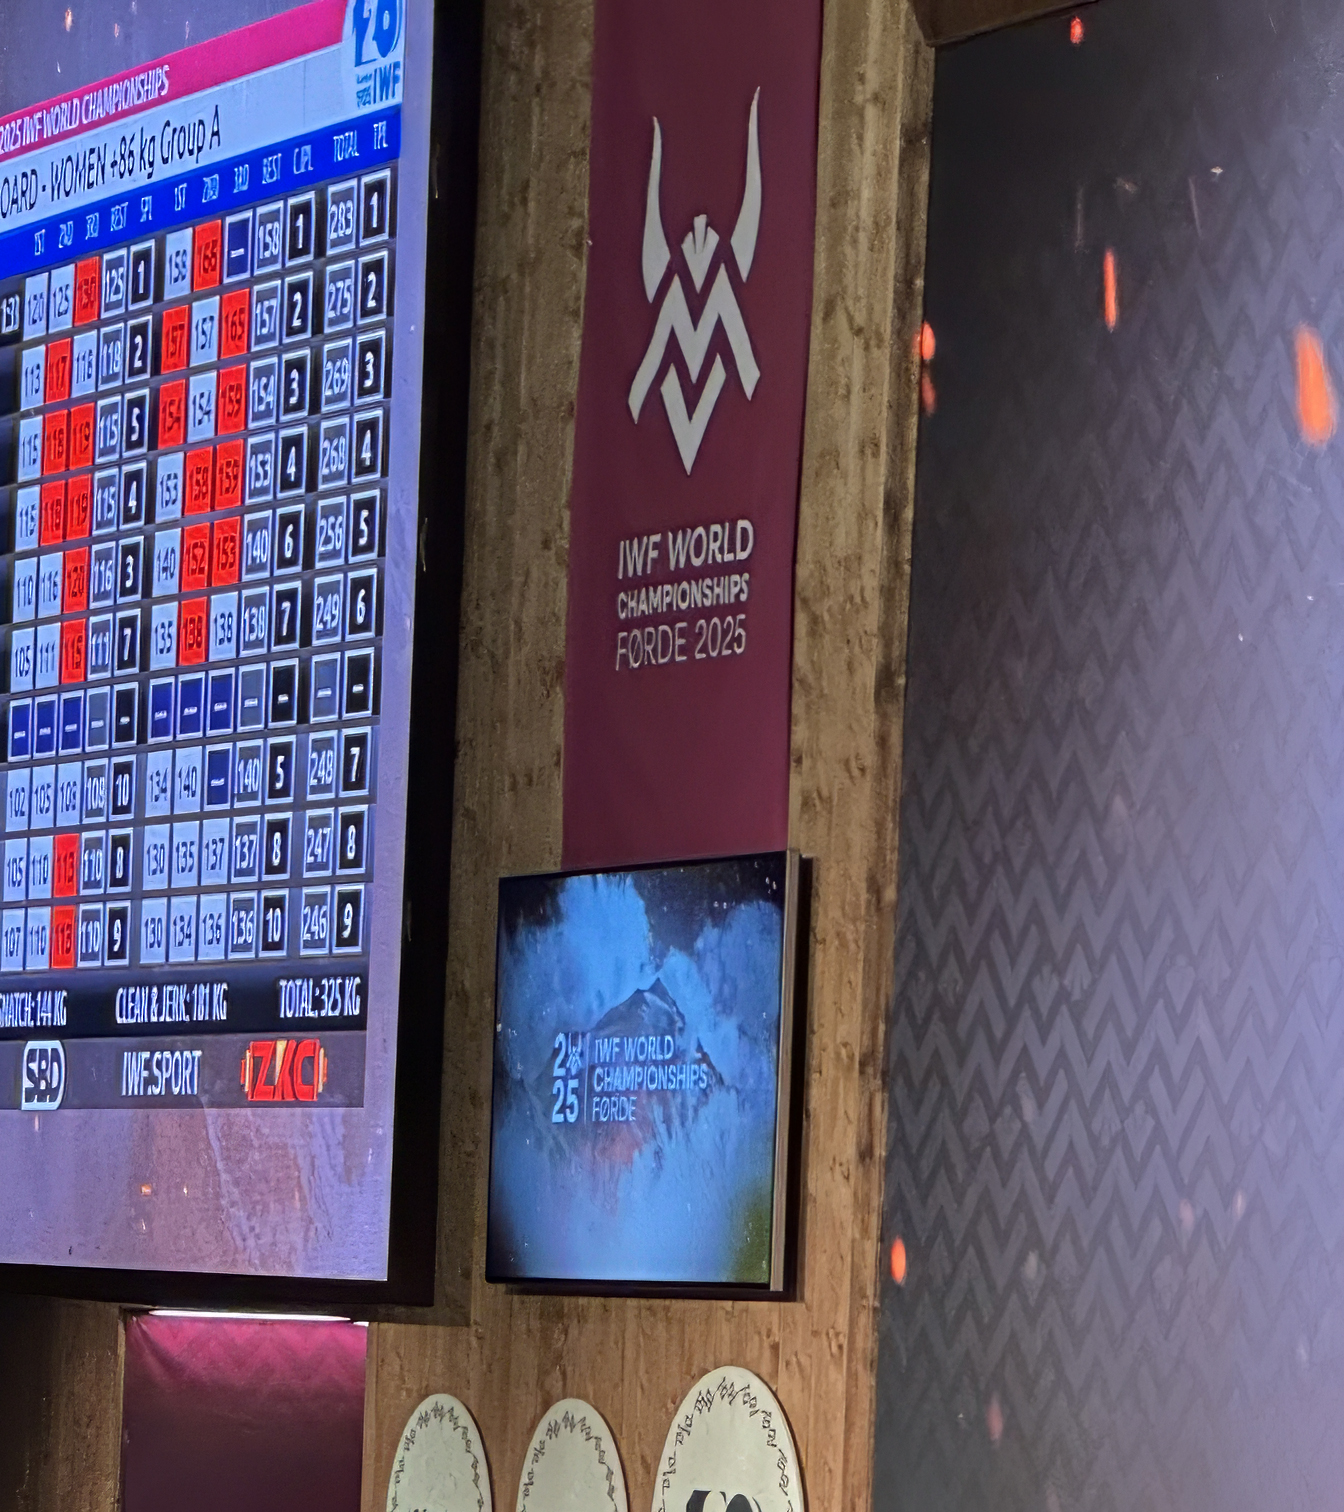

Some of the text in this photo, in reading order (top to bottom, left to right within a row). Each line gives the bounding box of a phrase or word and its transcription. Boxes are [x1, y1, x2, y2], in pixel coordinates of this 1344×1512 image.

[22, 110, 42, 146] IWF
[43, 98, 79, 138] WORLD
[82, 65, 169, 124] CHAMPIONSHIPS
[373, 61, 400, 104] IWF
[49, 142, 107, 204] WOMEN
[109, 131, 136, 183] +86
[138, 122, 156, 182] kg
[159, 107, 206, 175] Group
[209, 102, 222, 150] A
[104, 267, 124, 304] 125
[136, 261, 145, 295] 1
[257, 221, 280, 260] 158
[295, 213, 306, 249] 1
[329, 199, 355, 240] 283
[370, 191, 381, 228] 1
[101, 340, 121, 377] 118
[133, 334, 142, 368] 2
[254, 298, 277, 337] 157
[292, 291, 303, 327] 2
[326, 278, 352, 318] 275
[367, 270, 378, 307] 2
[98, 412, 118, 449] 115
[130, 407, 140, 442] 5
[252, 374, 274, 413] 154
[289, 368, 300, 404] 3
[323, 356, 349, 396] 269
[364, 349, 375, 386] 3
[96, 485, 116, 522] 115
[128, 480, 137, 515] 4
[249, 451, 271, 490] 153
[286, 445, 297, 482] 4
[320, 434, 346, 474] 268
[361, 428, 372, 466] 4
[93, 558, 113, 594] 116
[125, 554, 134, 588] 3
[246, 528, 268, 565] 140
[283, 523, 294, 558] 6
[317, 513, 342, 552] 256
[358, 508, 369, 544] 5
[617, 519, 754, 579] IWF WORLD
[617, 573, 749, 619] CHAMPIONSHIPS
[91, 631, 110, 666] 111
[122, 627, 132, 661] 7
[243, 604, 265, 642] 138
[281, 600, 291, 636] 7
[314, 591, 339, 630] 249
[354, 587, 365, 624] 6
[616, 614, 746, 671] FØRDE 2025
[114, 773, 129, 807] 10
[237, 757, 259, 793] 140
[275, 754, 285, 788] 5
[308, 748, 333, 785] 248
[348, 744, 359, 780] 7
[83, 849, 103, 881] 110
[114, 846, 124, 879] 8
[234, 833, 256, 868] 137
[272, 831, 282, 865] 8
[305, 826, 330, 862] 247
[345, 823, 356, 858] 8
[80, 920, 100, 953] 110
[112, 919, 121, 951] 9
[231, 909, 253, 944] 136
[265, 907, 281, 941] 10
[302, 903, 327, 939] 246
[342, 902, 353, 937] 9
[53, 990, 67, 1026] KG
[115, 986, 150, 1024] CLEAN
[212, 982, 227, 1020] KG
[277, 975, 360, 1018] TOTAL: 325 KG
[23, 1043, 63, 1107] SBD
[122, 1049, 201, 1095] IWF.SPORT
[594, 1035, 674, 1063] IWF WORLD
[552, 1079, 579, 1123] 25
[593, 1064, 707, 1092] CHAMPIONSHIPS
[592, 1097, 637, 1122] FØRDE
